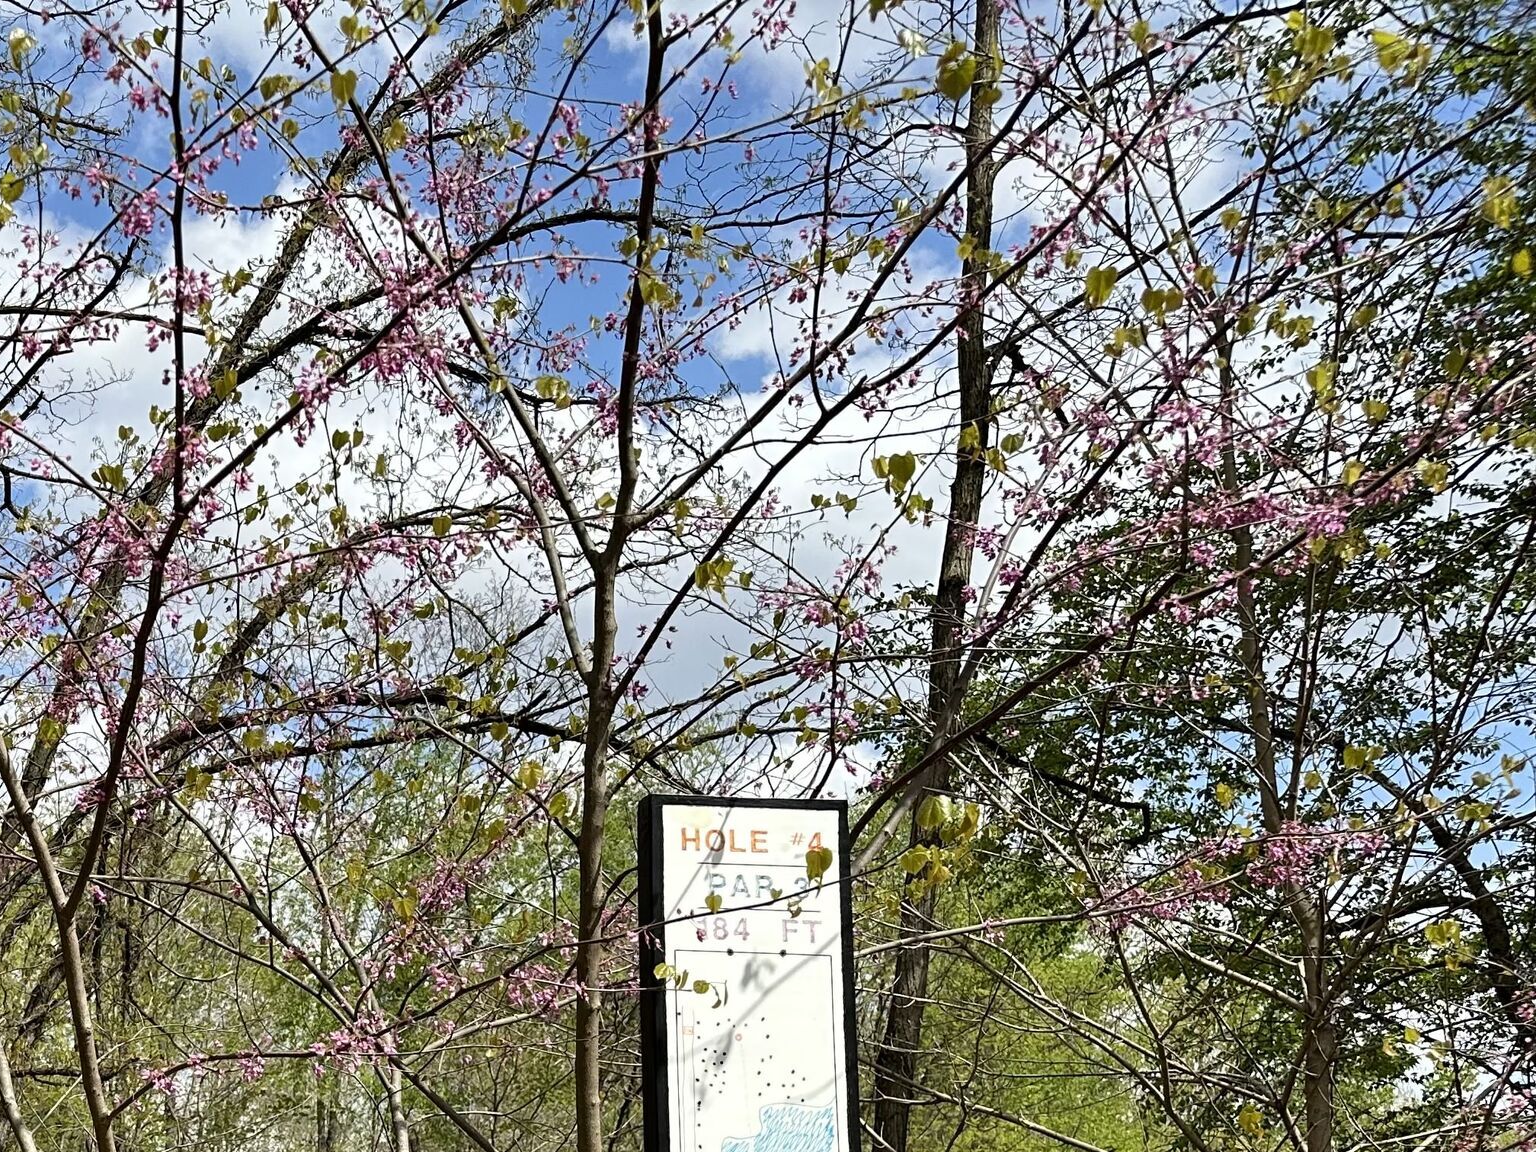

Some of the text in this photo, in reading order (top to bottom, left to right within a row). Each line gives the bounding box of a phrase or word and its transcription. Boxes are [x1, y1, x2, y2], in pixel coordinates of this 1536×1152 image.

[681, 828, 823, 853] HOLE #4
[710, 873, 810, 899] PAR 3
[781, 919, 823, 943] FT
